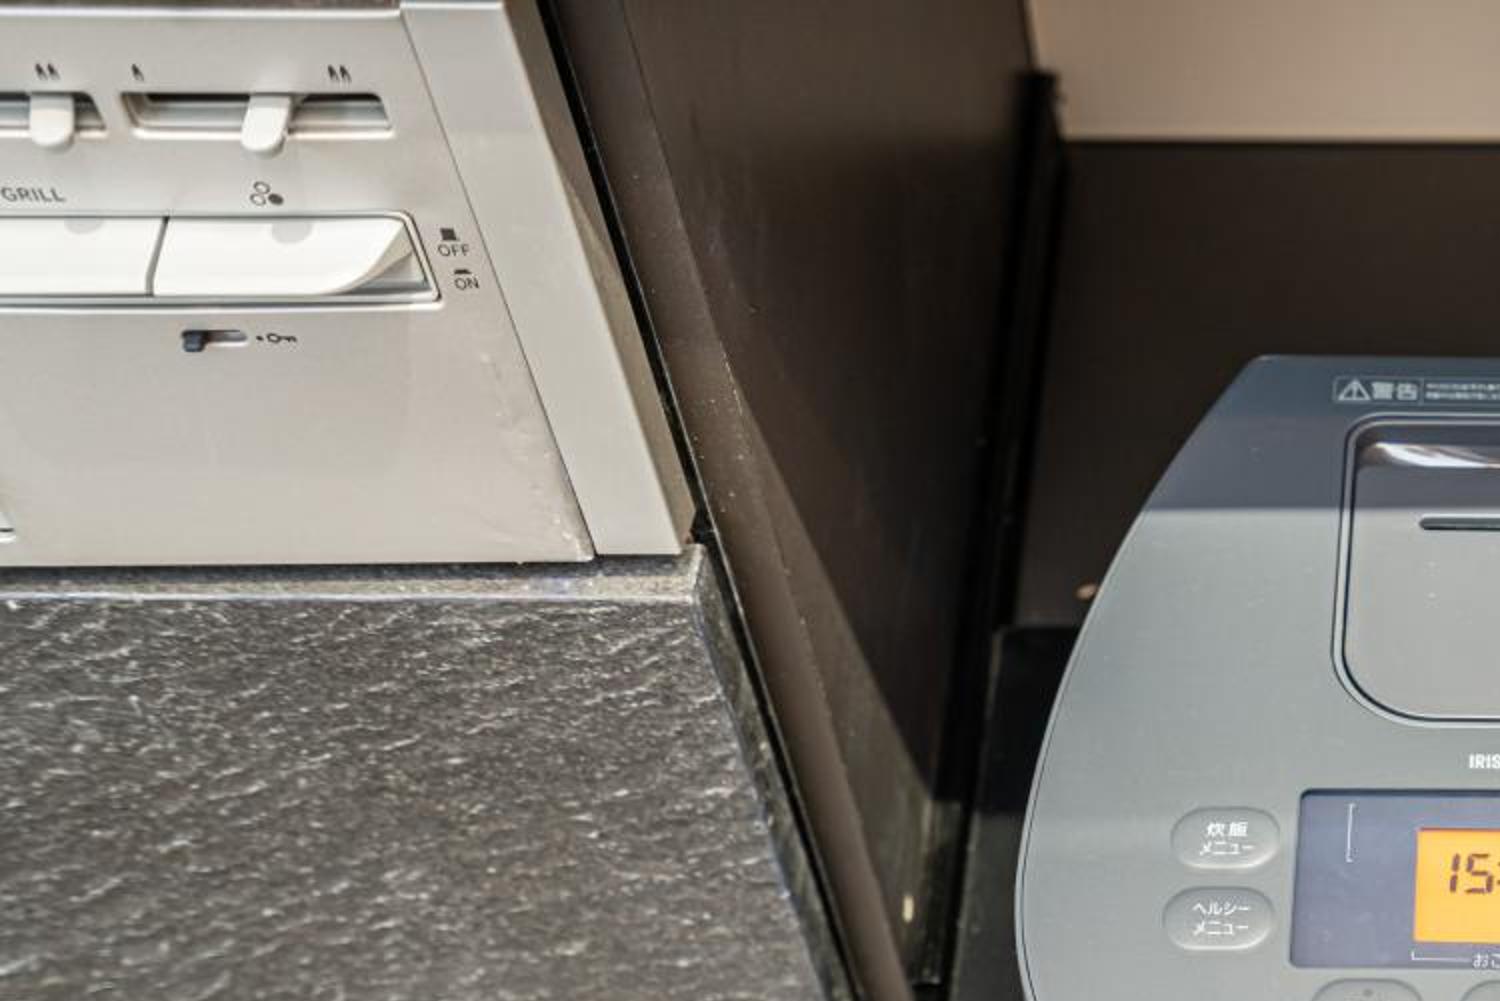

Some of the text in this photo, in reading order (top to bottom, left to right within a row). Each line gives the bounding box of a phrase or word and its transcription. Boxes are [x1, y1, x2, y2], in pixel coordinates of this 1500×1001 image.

[0, 186, 66, 202] GRILL
[437, 243, 470, 257] OFF
[454, 277, 479, 291] ON
[1206, 821, 1248, 838] 炊飯
[1199, 842, 1254, 856] メニュー
[1192, 902, 1250, 917] ヘルシー
[1192, 922, 1249, 937] メニュー
